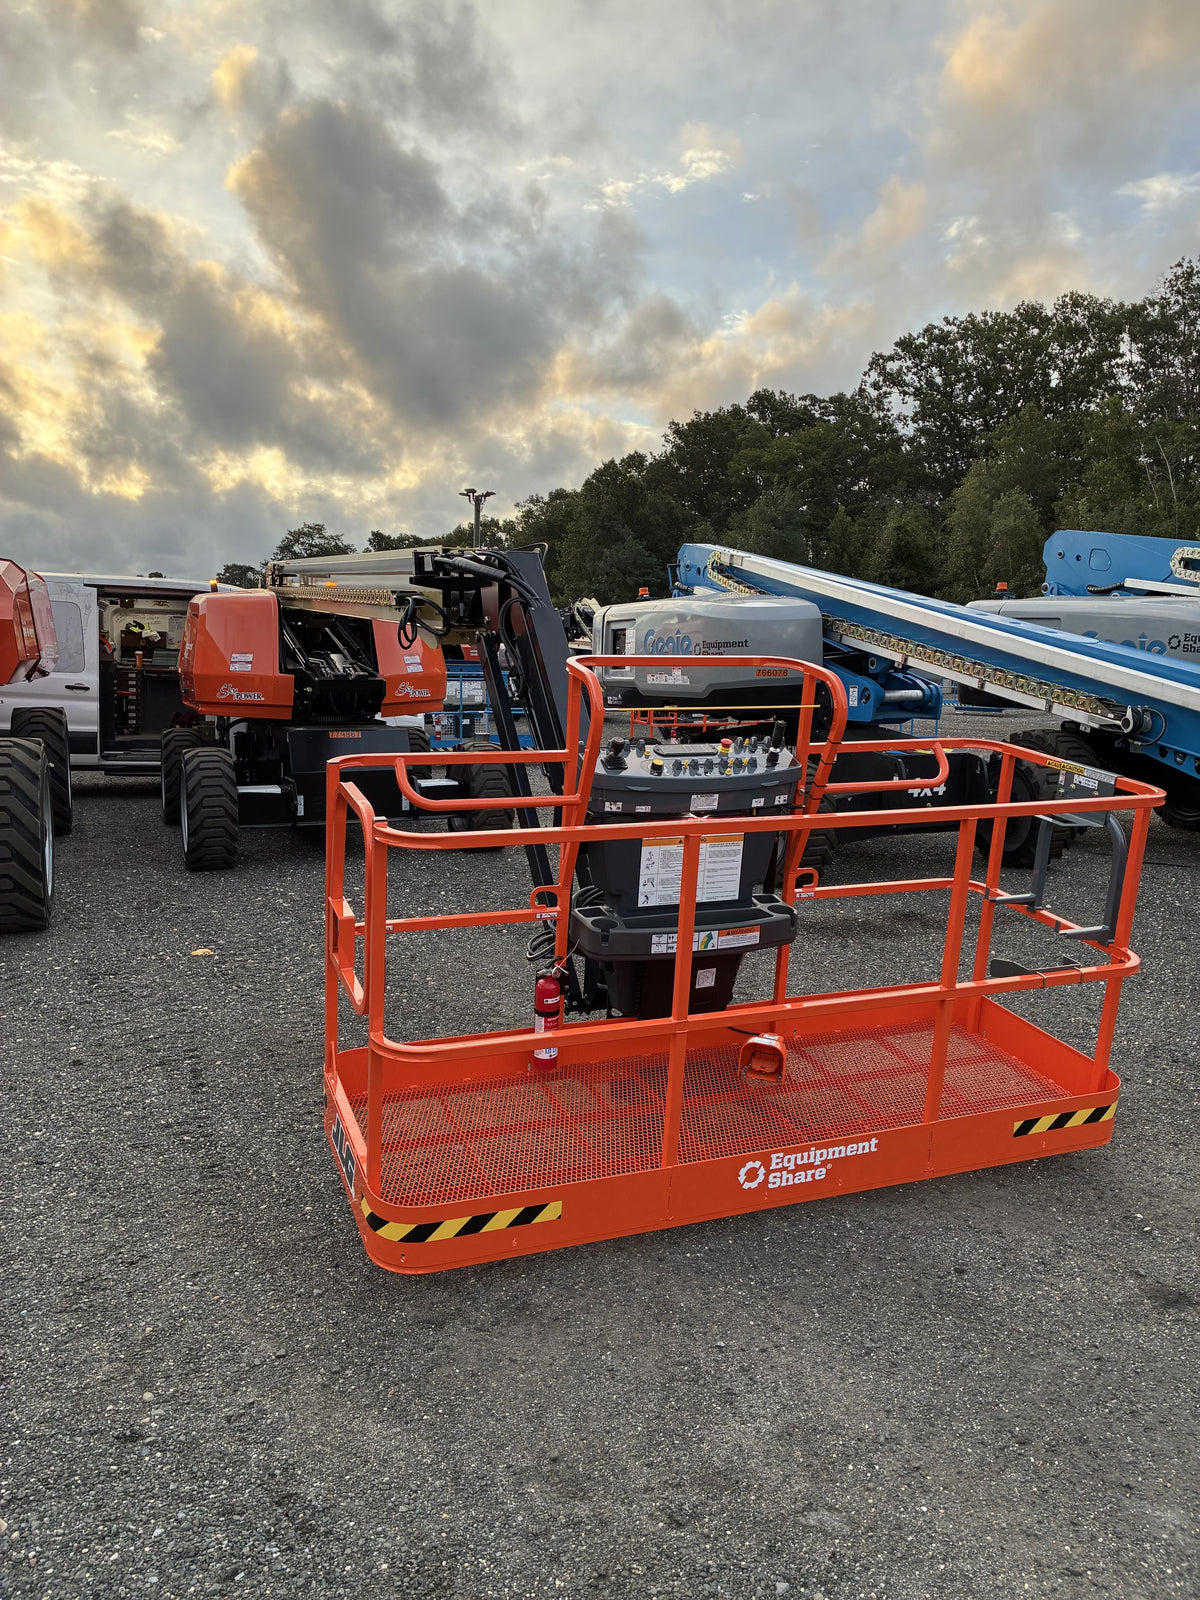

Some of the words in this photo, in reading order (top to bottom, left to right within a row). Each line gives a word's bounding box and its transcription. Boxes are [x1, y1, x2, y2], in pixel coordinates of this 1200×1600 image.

[644, 629, 692, 655] Genie
[702, 639, 749, 650] Equipment
[756, 669, 788, 677] 766076
[770, 1138, 878, 1170] Equipment
